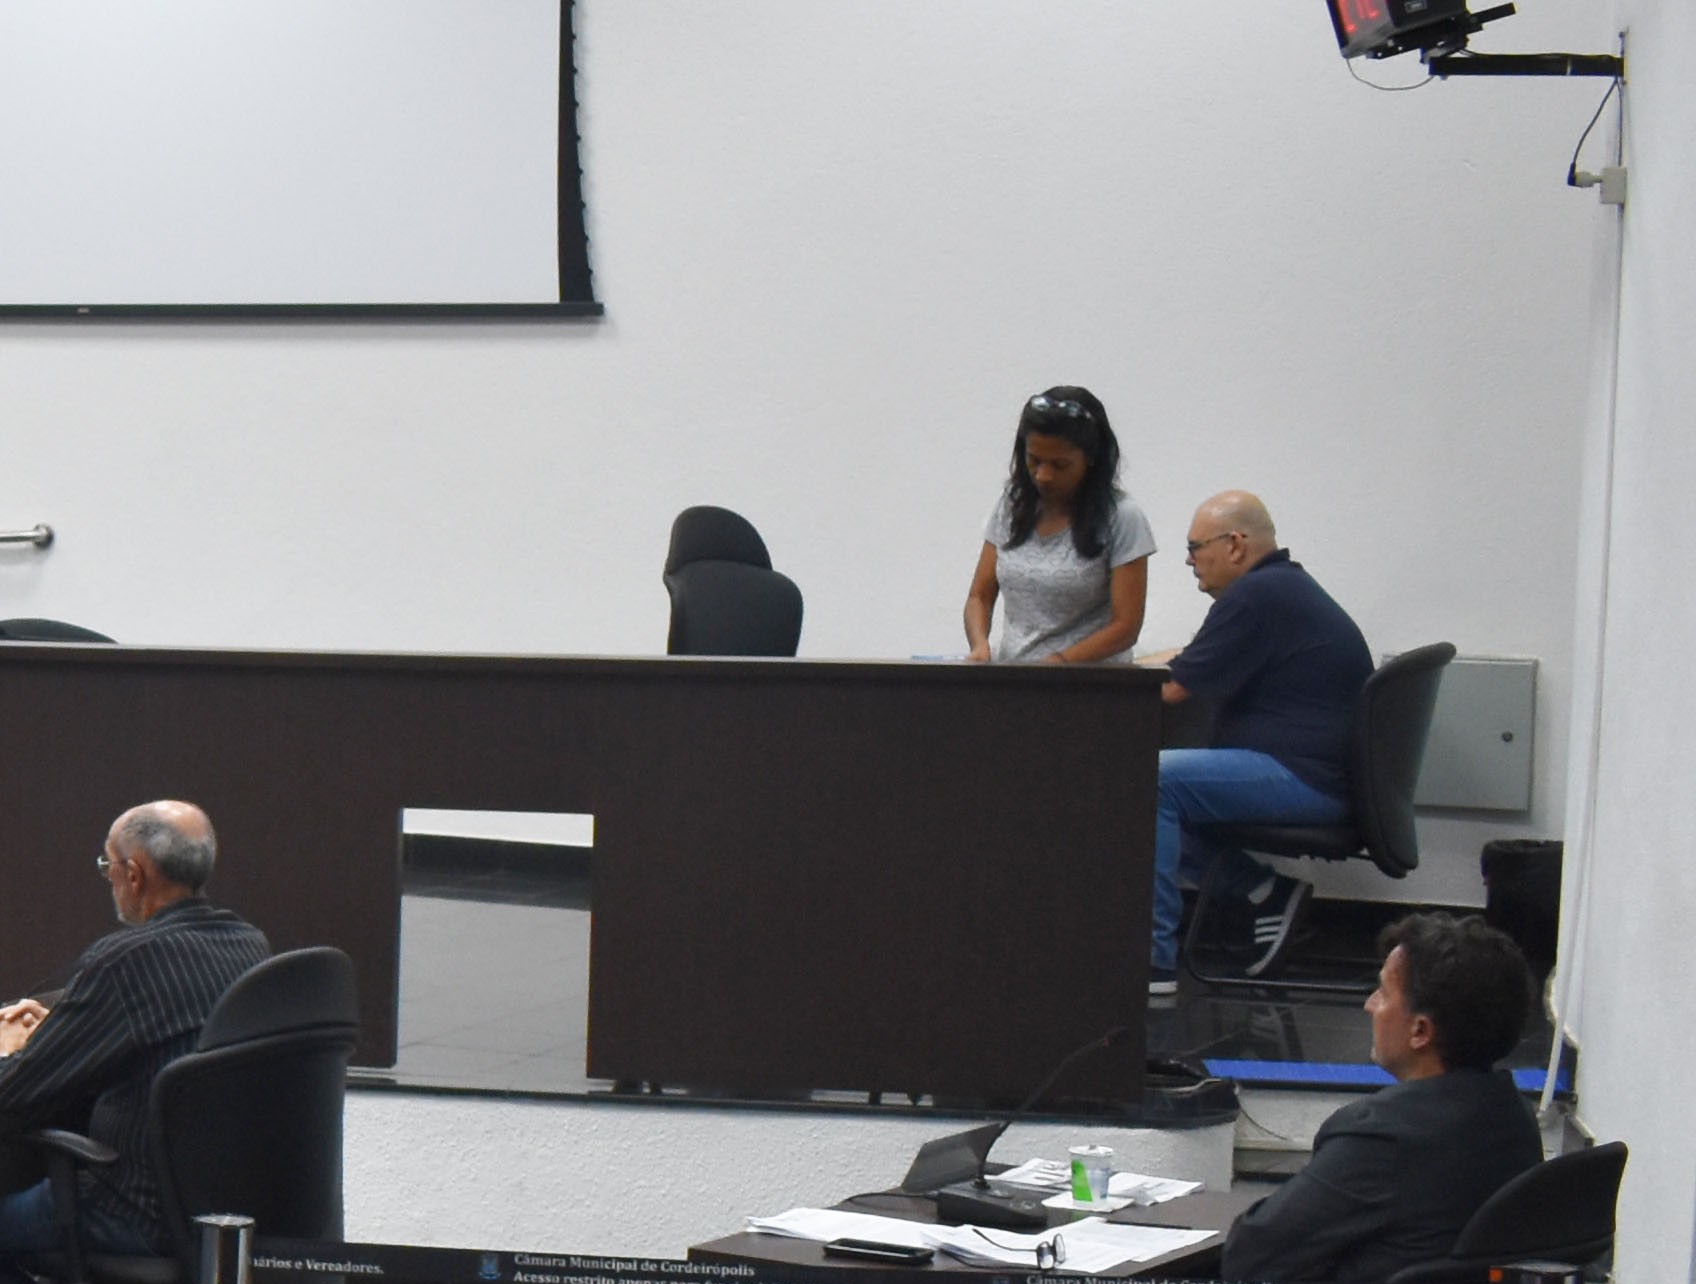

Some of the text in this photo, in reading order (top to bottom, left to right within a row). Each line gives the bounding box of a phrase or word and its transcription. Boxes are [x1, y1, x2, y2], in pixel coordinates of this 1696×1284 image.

[294, 1261, 303, 1269] e
[305, 1259, 385, 1275] Vereadores.
[514, 1253, 755, 1278] Câmara Municipal de Cordeirópolis
[514, 1271, 559, 1284] Acesso
